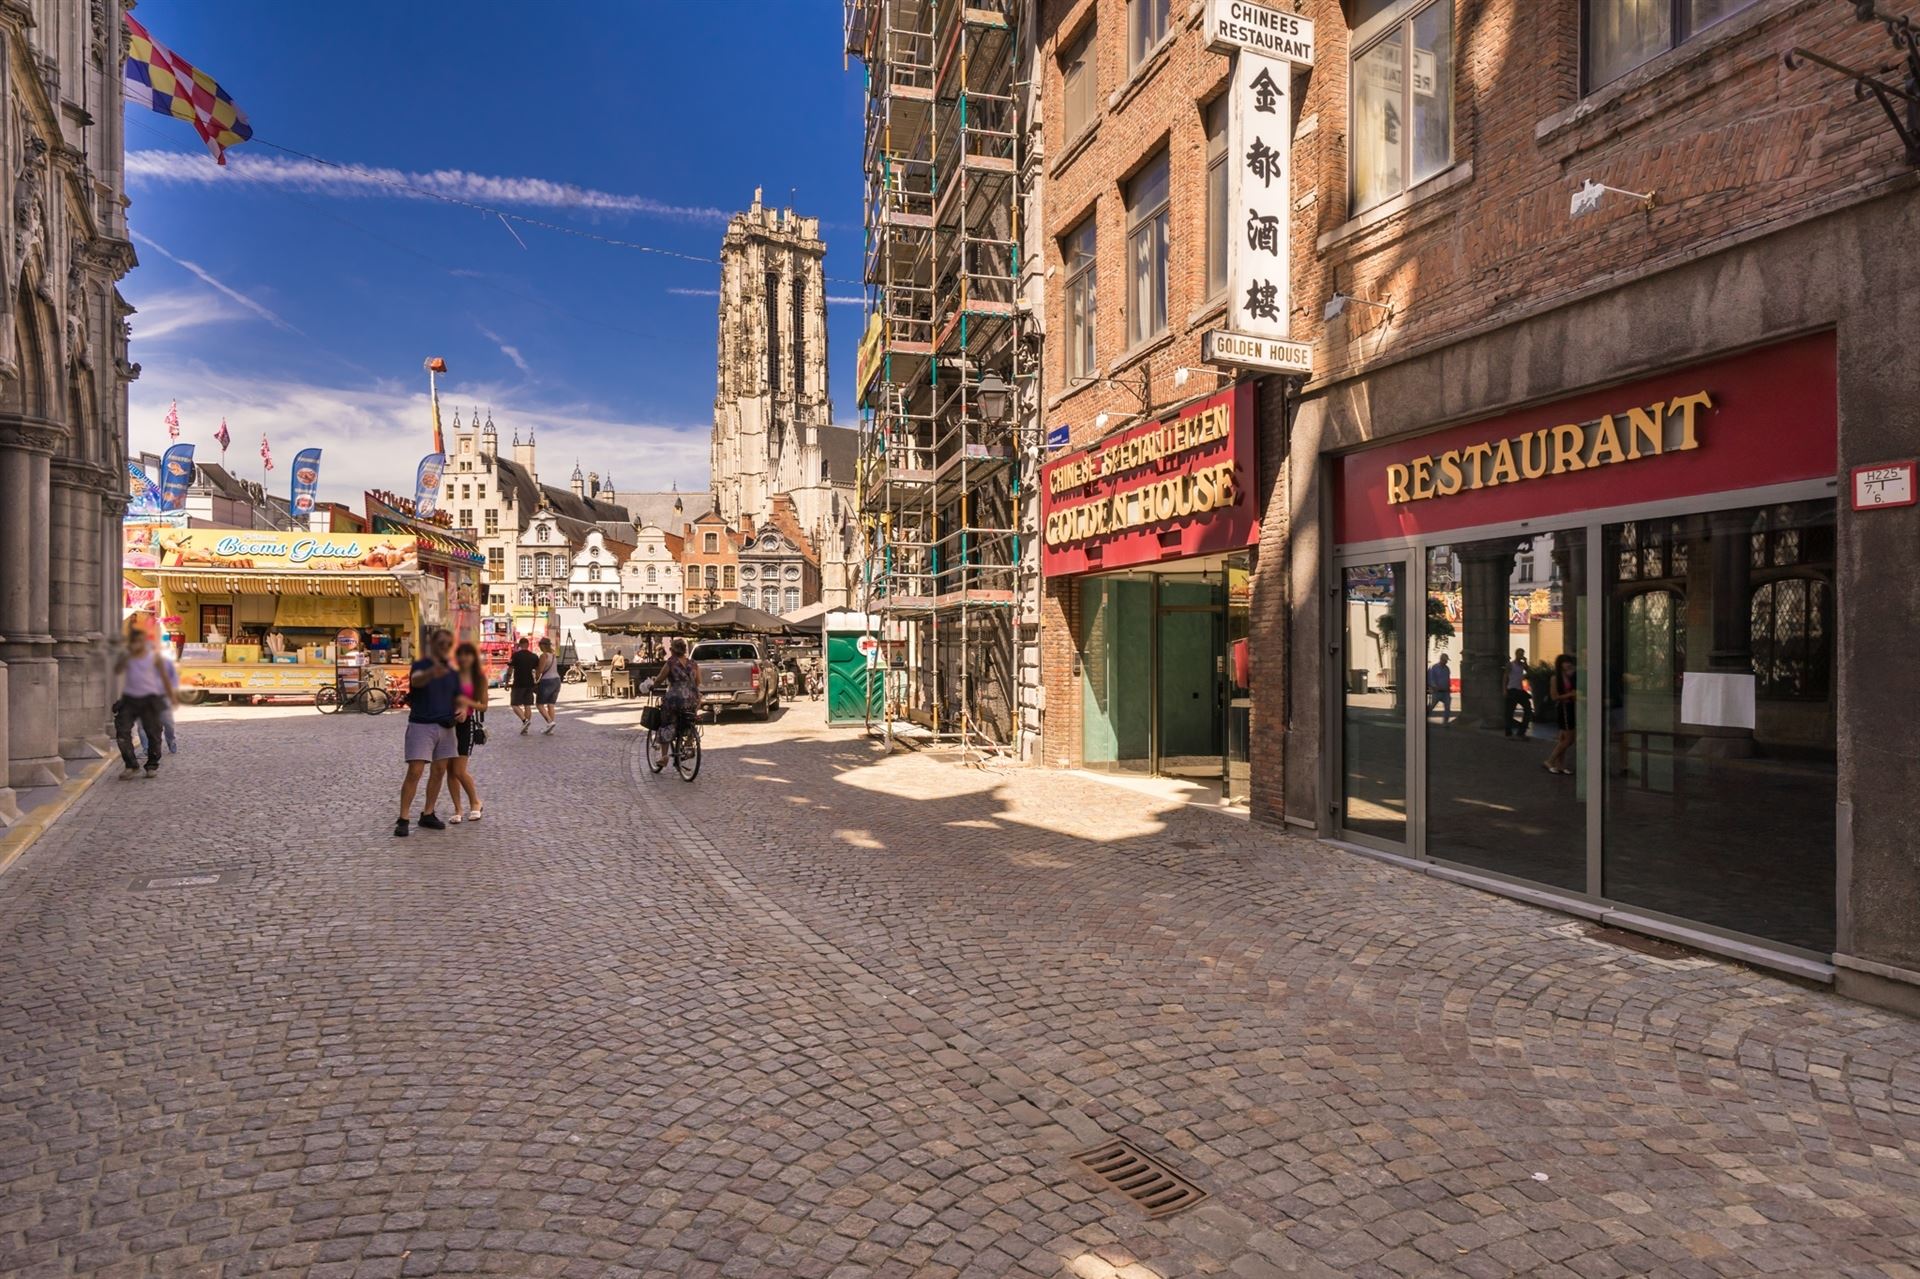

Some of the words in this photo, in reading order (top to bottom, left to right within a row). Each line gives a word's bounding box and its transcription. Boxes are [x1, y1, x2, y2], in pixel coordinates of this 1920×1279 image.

[1231, 2, 1299, 36] CHINEES
[1220, 20, 1311, 59] RESTAURANT
[1243, 66, 1285, 323] 金都酒樓
[1217, 337, 1262, 358] GOLDEN
[1270, 344, 1308, 365] HOUSE
[1386, 390, 1712, 505] RESTAURANT
[1050, 453, 1099, 495] CHINESE
[1867, 469, 1898, 481] H225
[1046, 491, 1129, 546] GOLDEN
[1137, 459, 1236, 525] HOUSE
[216, 536, 288, 556] Booms
[289, 538, 362, 563] Gebak
